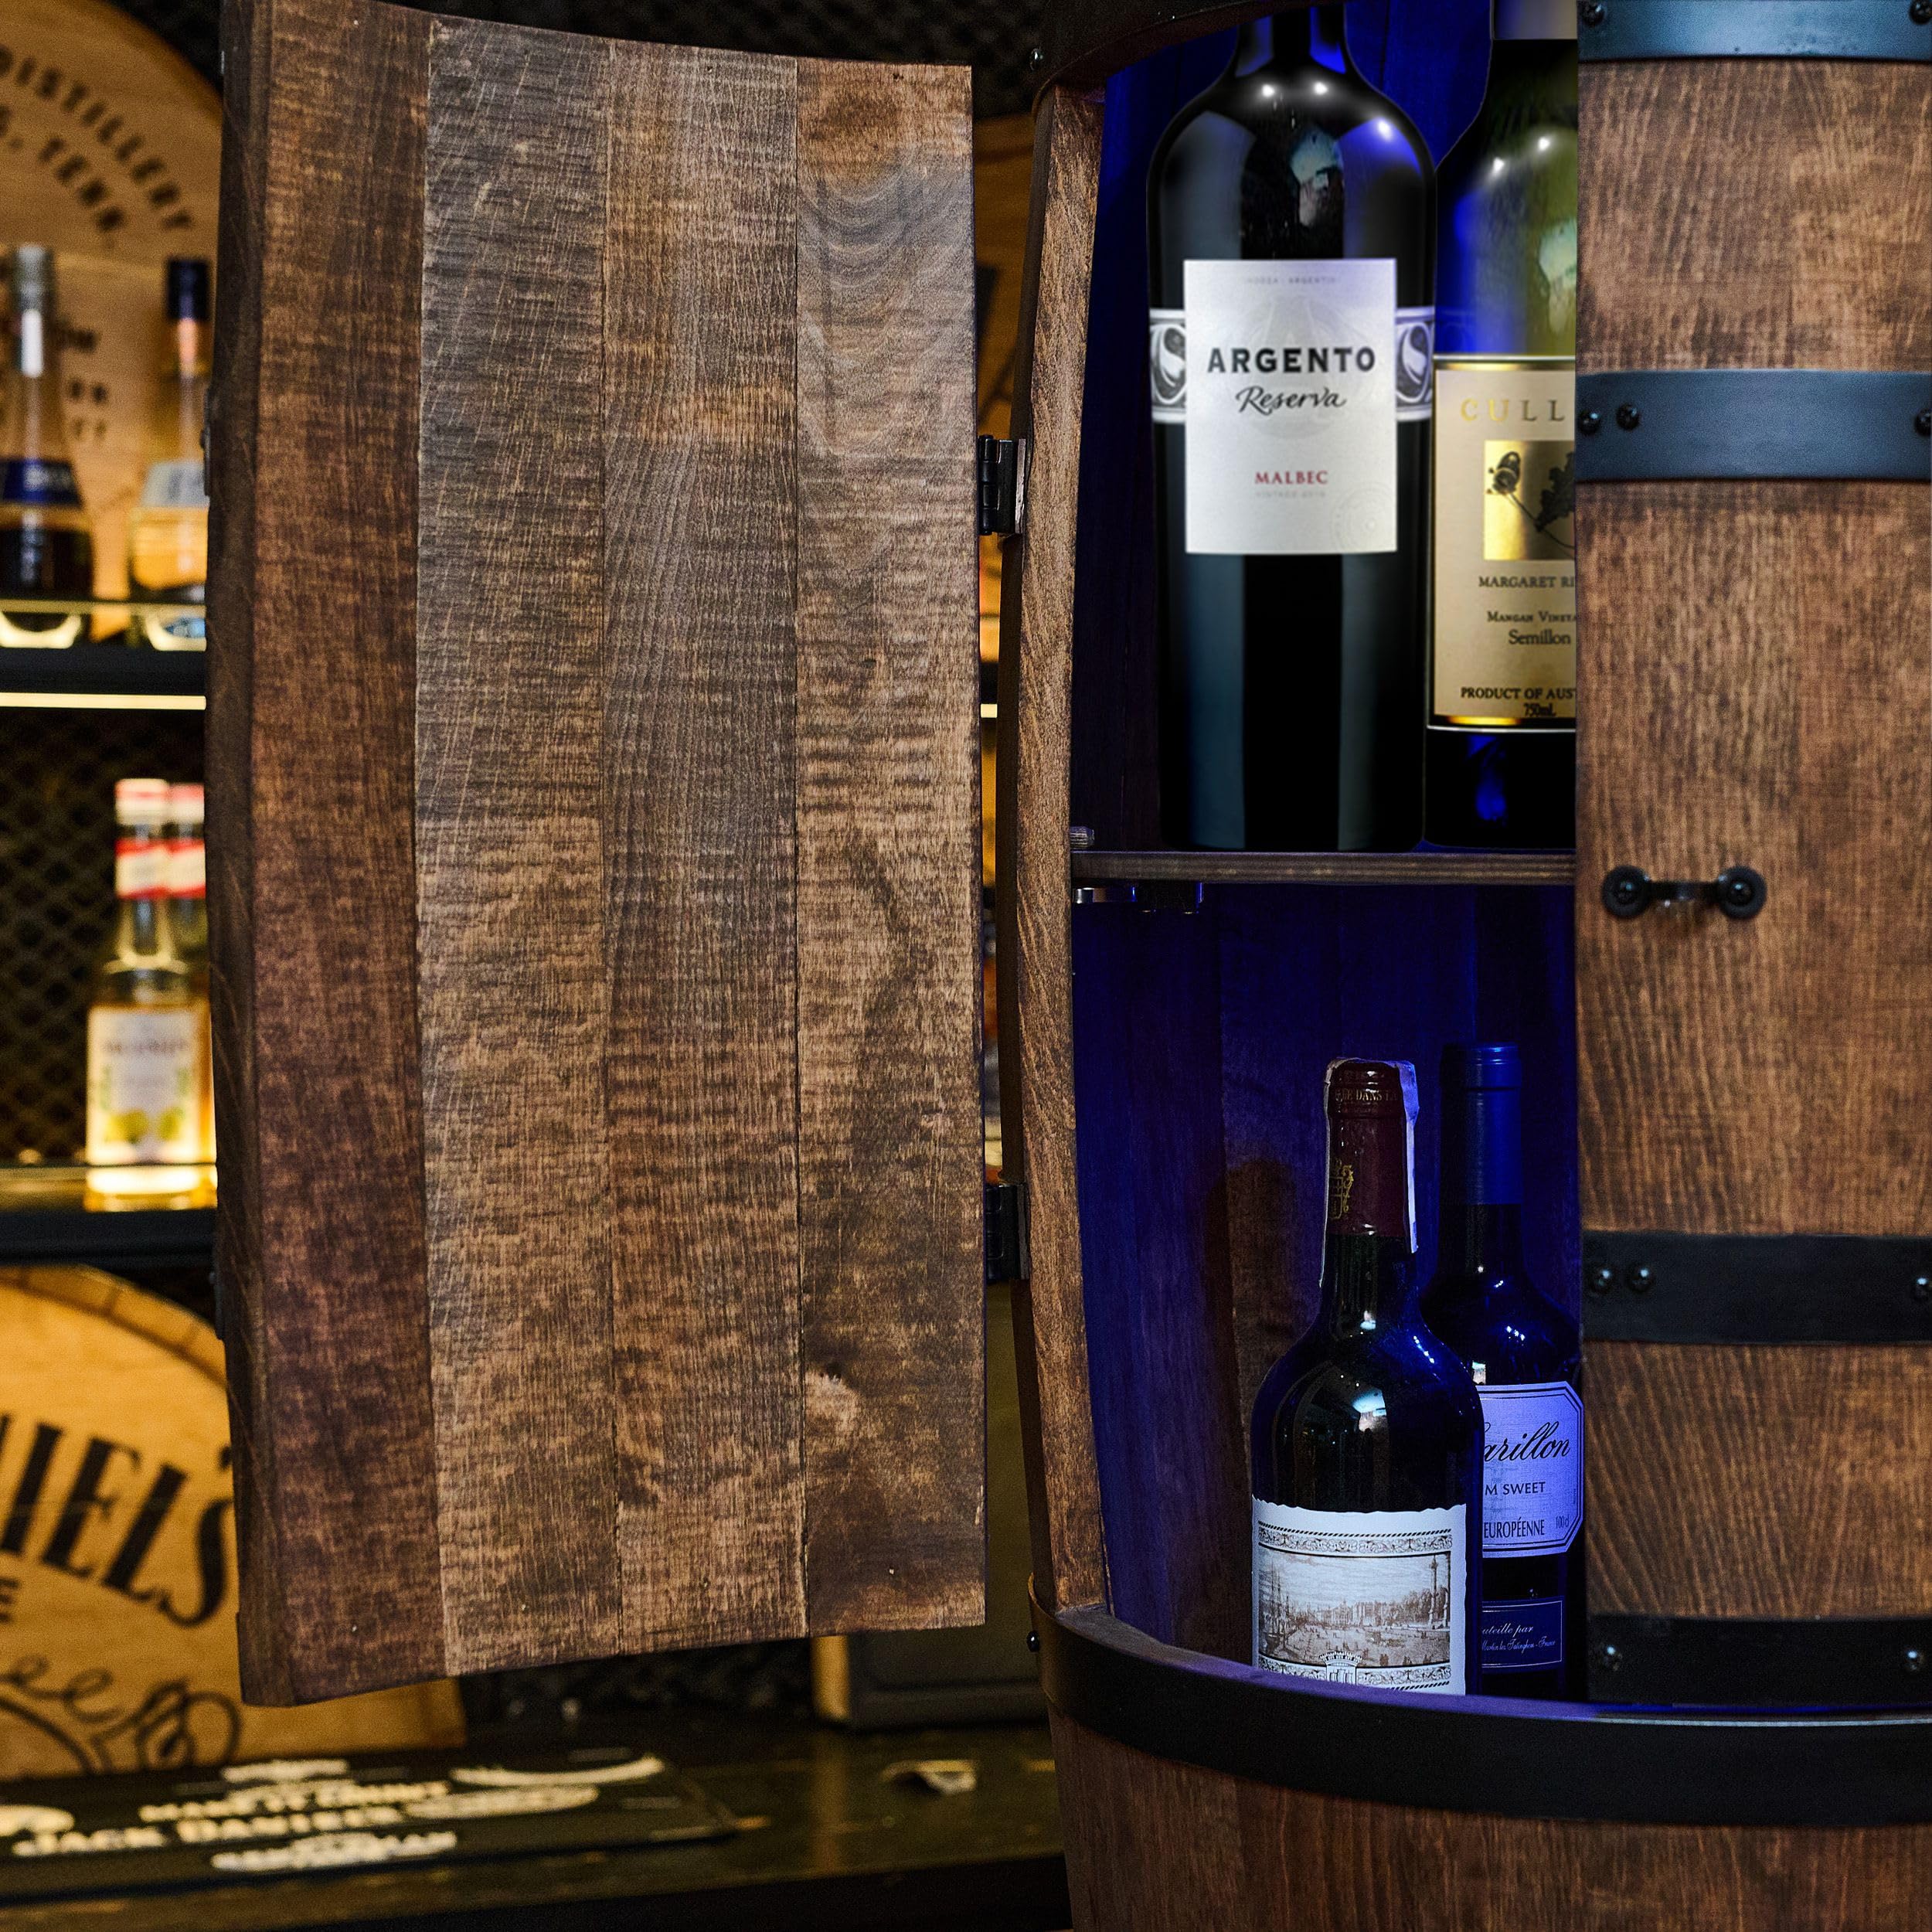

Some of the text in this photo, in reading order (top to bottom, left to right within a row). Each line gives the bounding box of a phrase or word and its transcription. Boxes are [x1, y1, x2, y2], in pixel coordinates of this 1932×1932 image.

[1208, 347, 1375, 373] ARGENTO
[1236, 386, 1346, 416] Reserva
[1460, 398, 1566, 422] CULL
[1254, 470, 1328, 485] MALBEC
[1478, 576, 1557, 588] MARGARET
[1509, 628, 1571, 645] Semillon
[1461, 687, 1522, 699] PRODUCT
[1524, 687, 1543, 699] OF
[1502, 1481, 1546, 1495] SWEET
[1483, 1516, 1545, 1539] EUROPÉENNE
